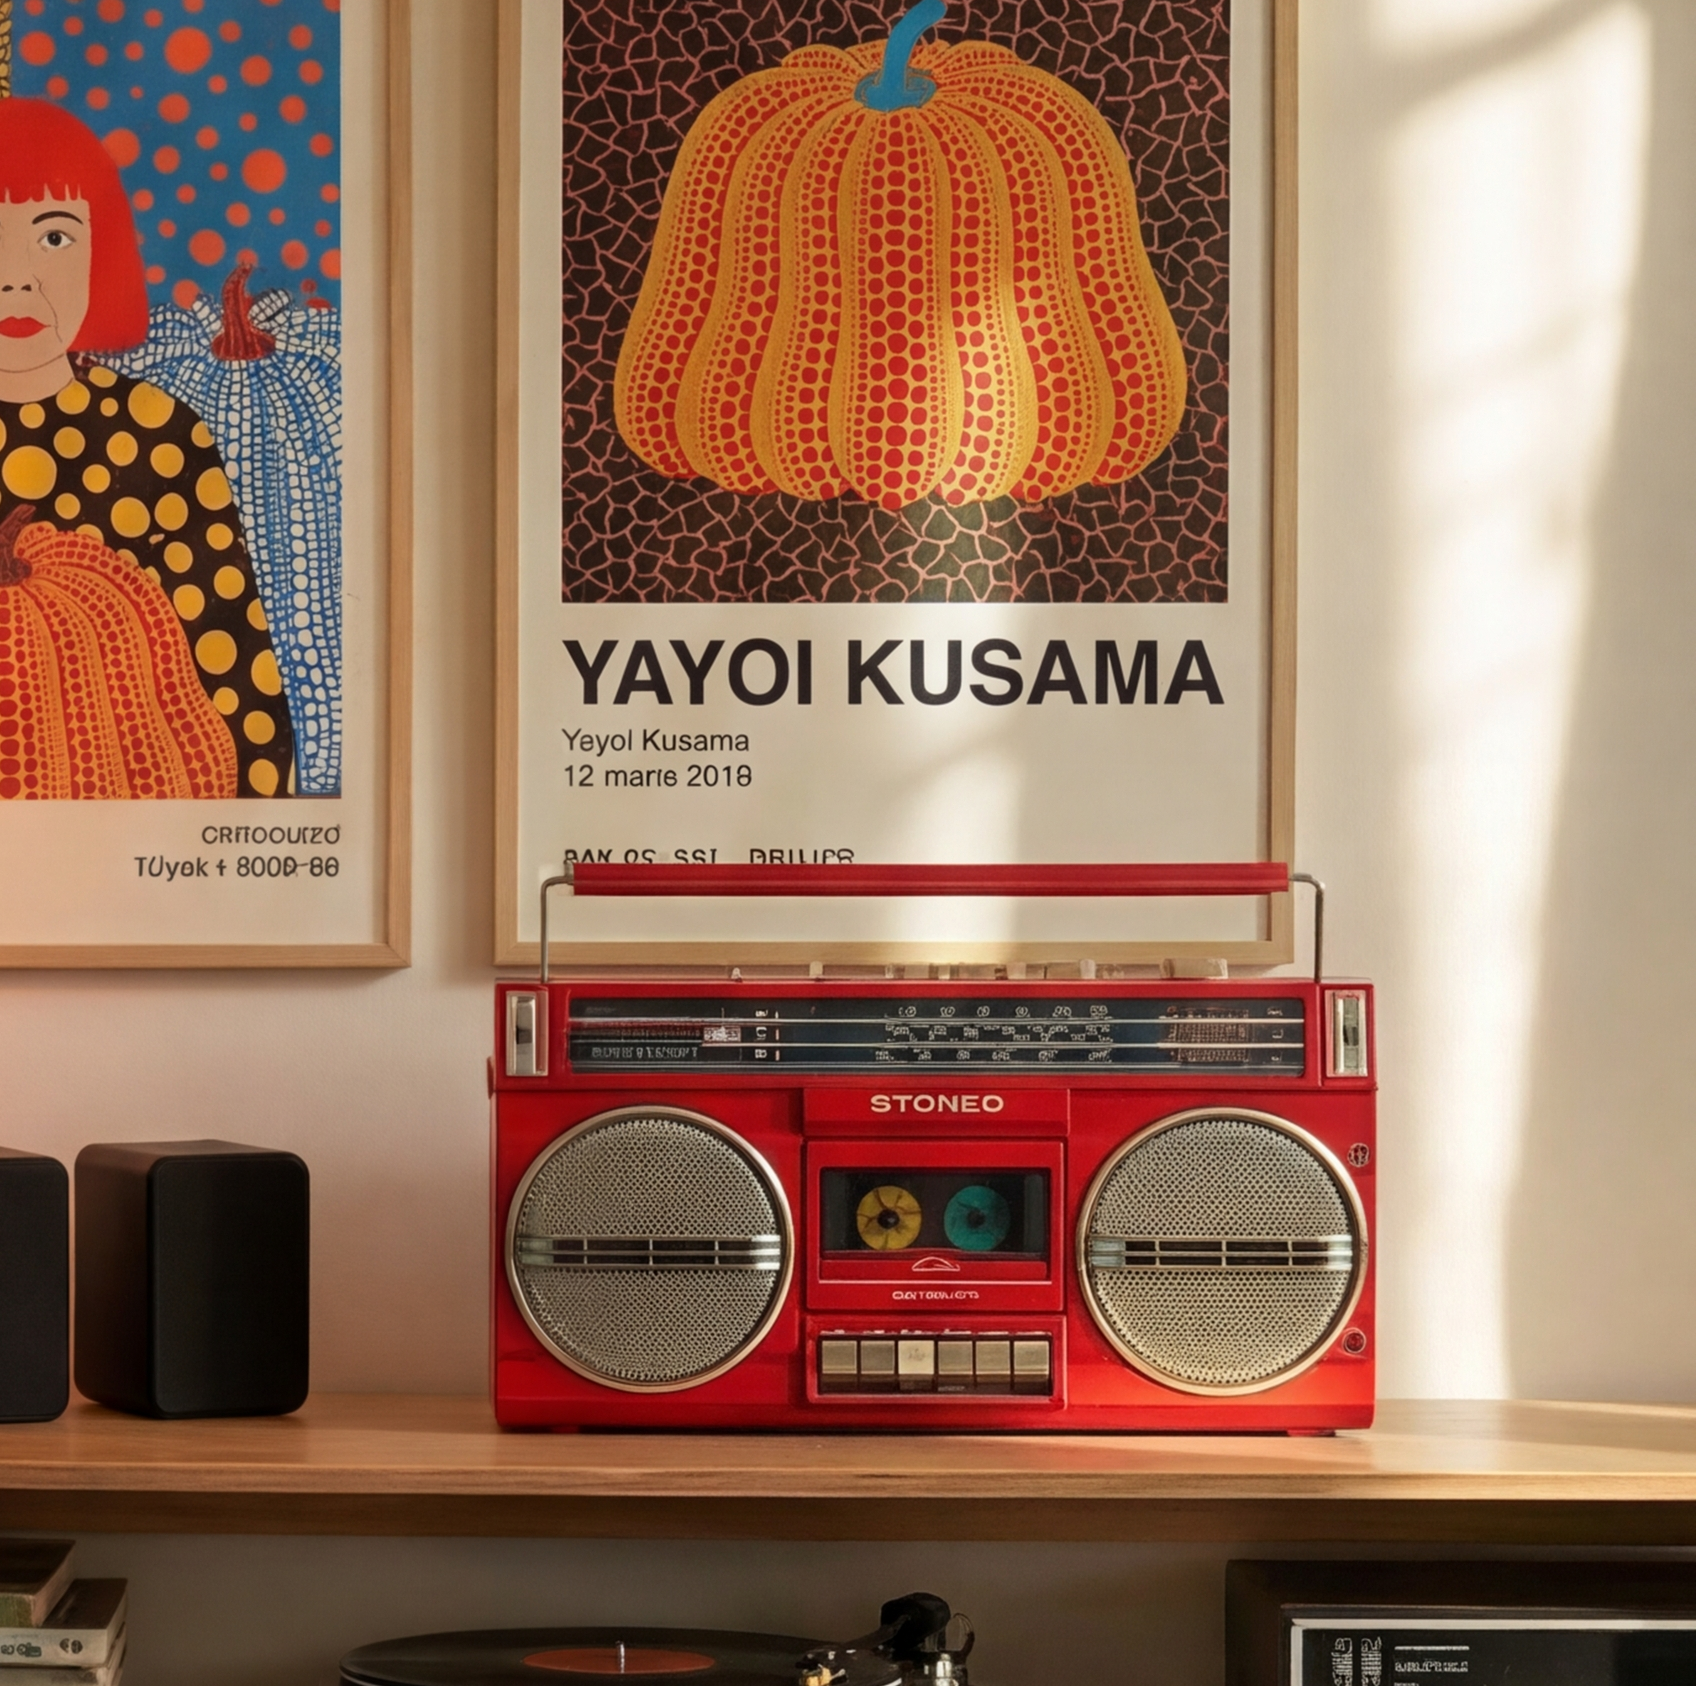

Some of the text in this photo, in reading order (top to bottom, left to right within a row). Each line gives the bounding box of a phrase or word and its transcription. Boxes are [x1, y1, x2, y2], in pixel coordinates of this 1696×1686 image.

[561, 637, 1226, 706] YAYOI KUSAMA
[642, 728, 750, 752] Kusama
[564, 764, 594, 787] 12
[870, 1094, 1004, 1113] STONEO
